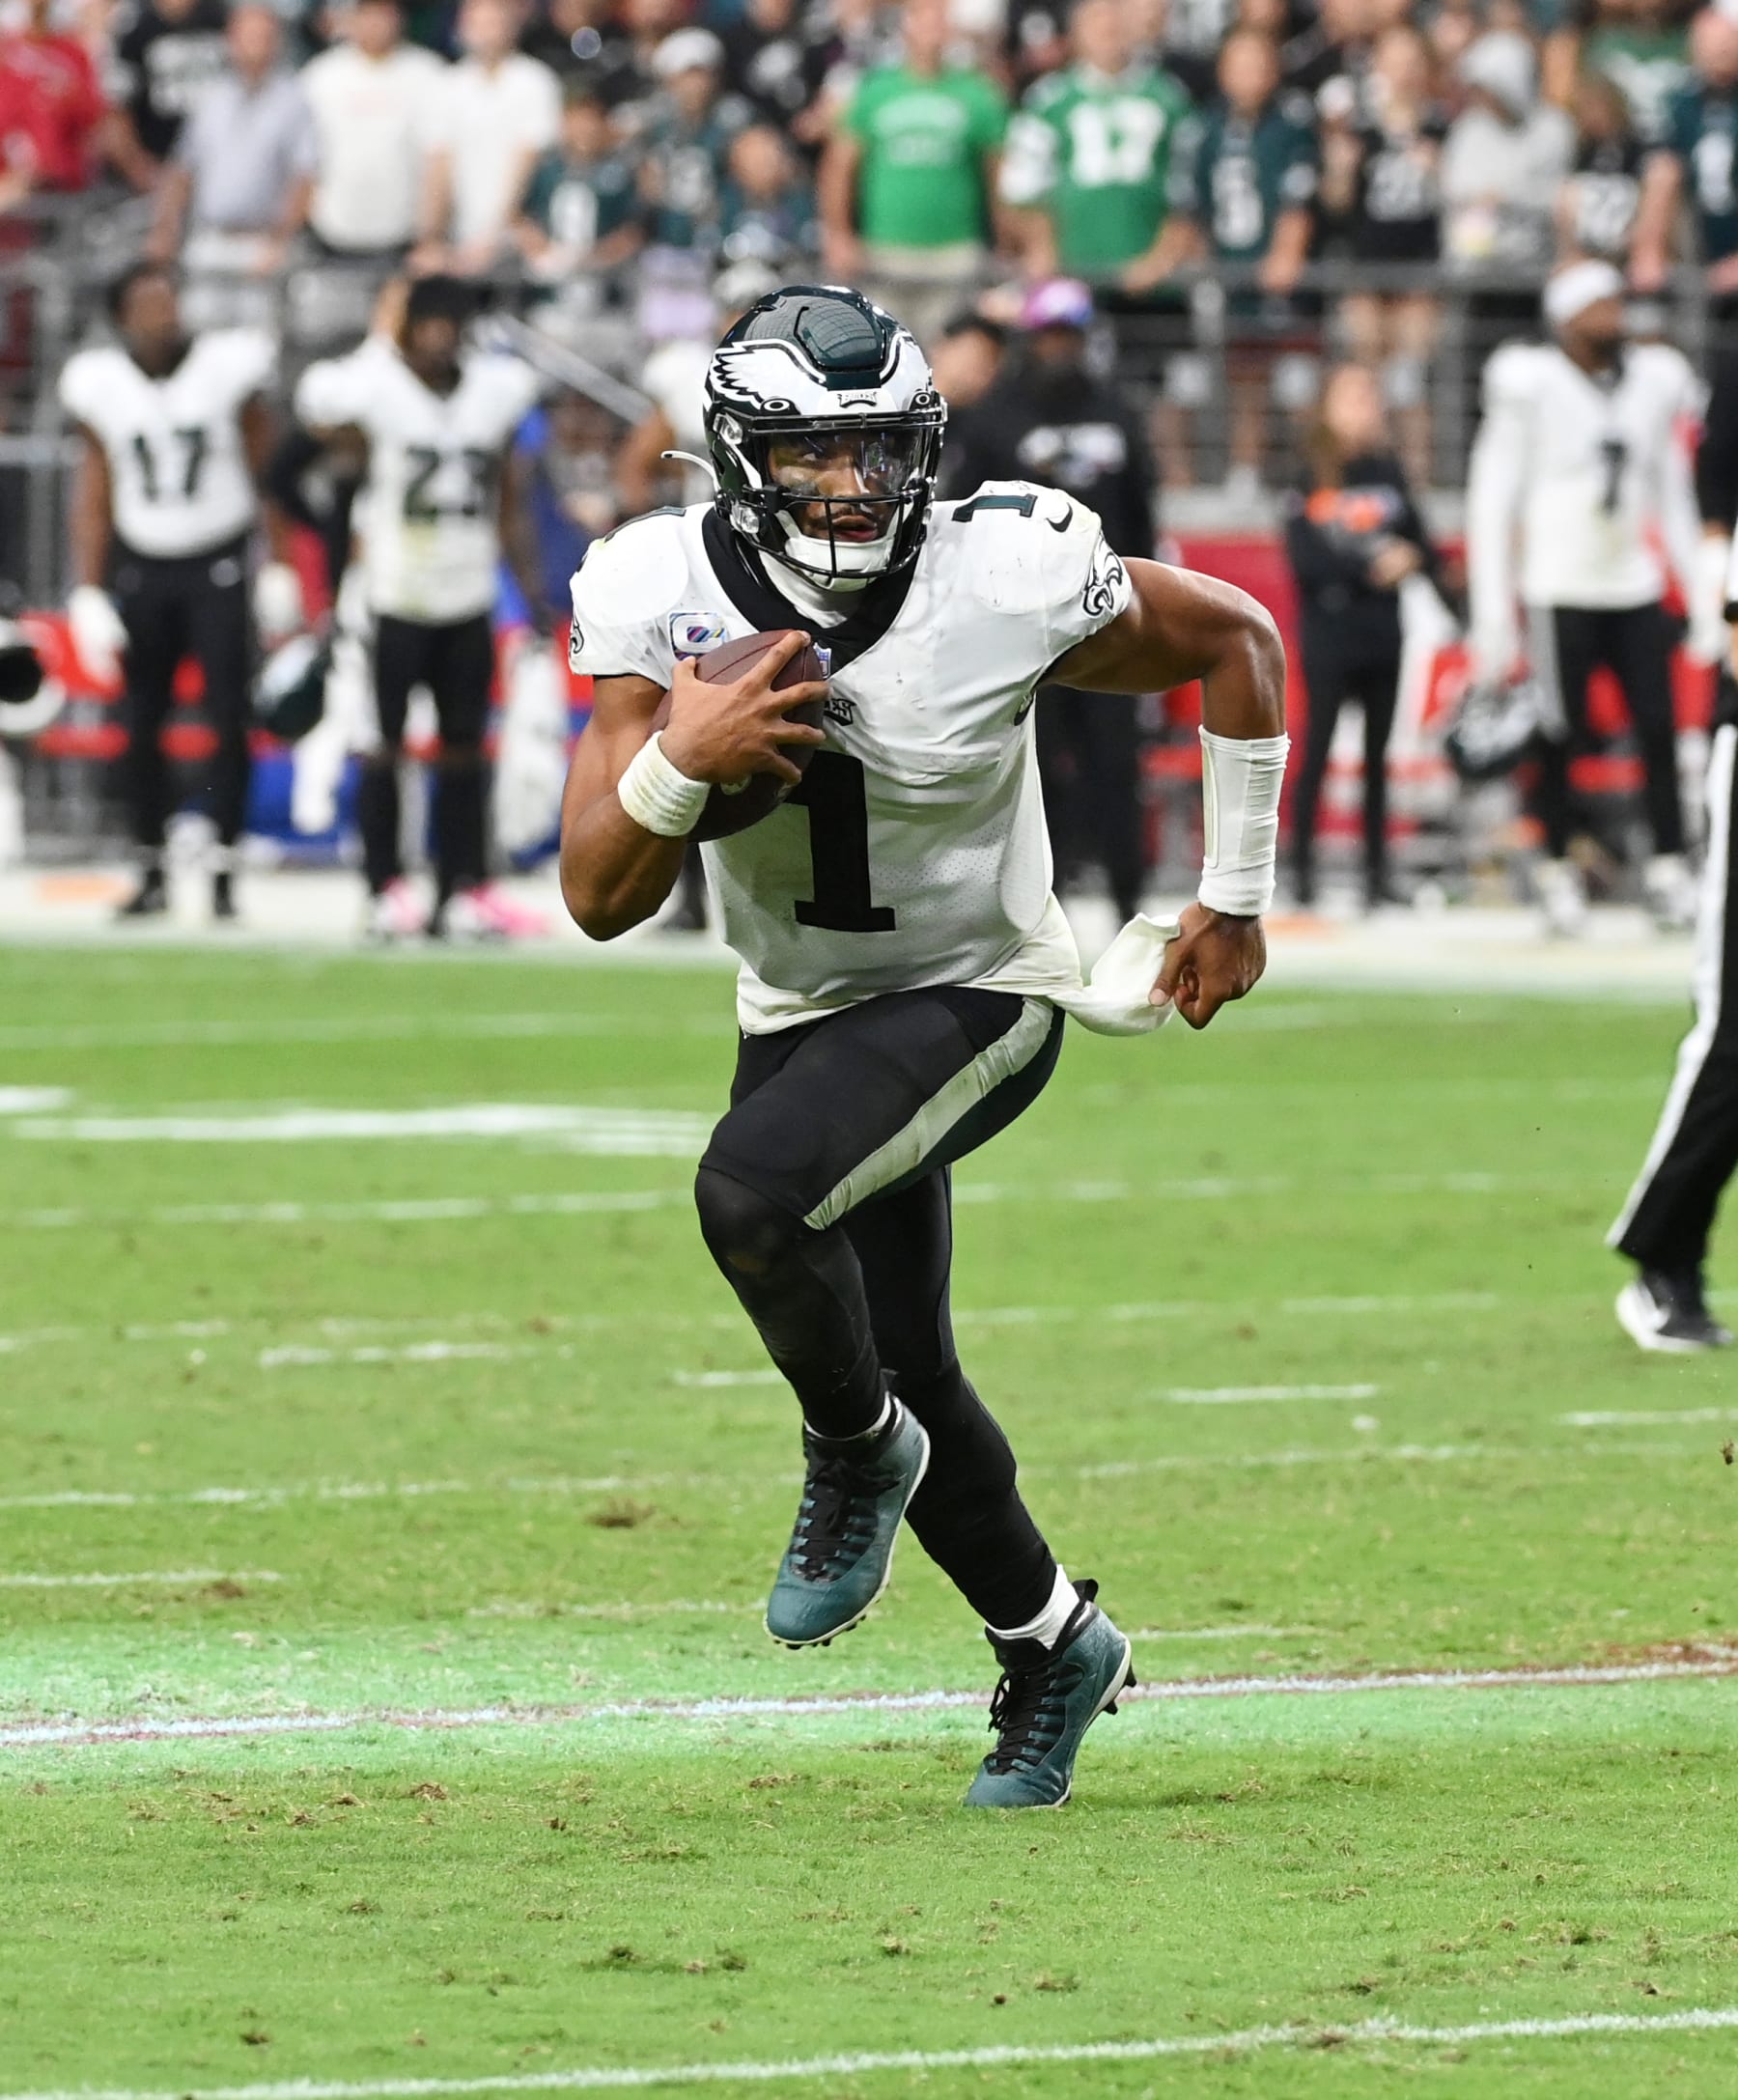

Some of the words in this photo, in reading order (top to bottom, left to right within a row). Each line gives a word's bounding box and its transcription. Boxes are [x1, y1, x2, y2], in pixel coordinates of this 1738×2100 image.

[132, 425, 210, 504] 17
[672, 614, 724, 654] C
[783, 749, 896, 933] 1
